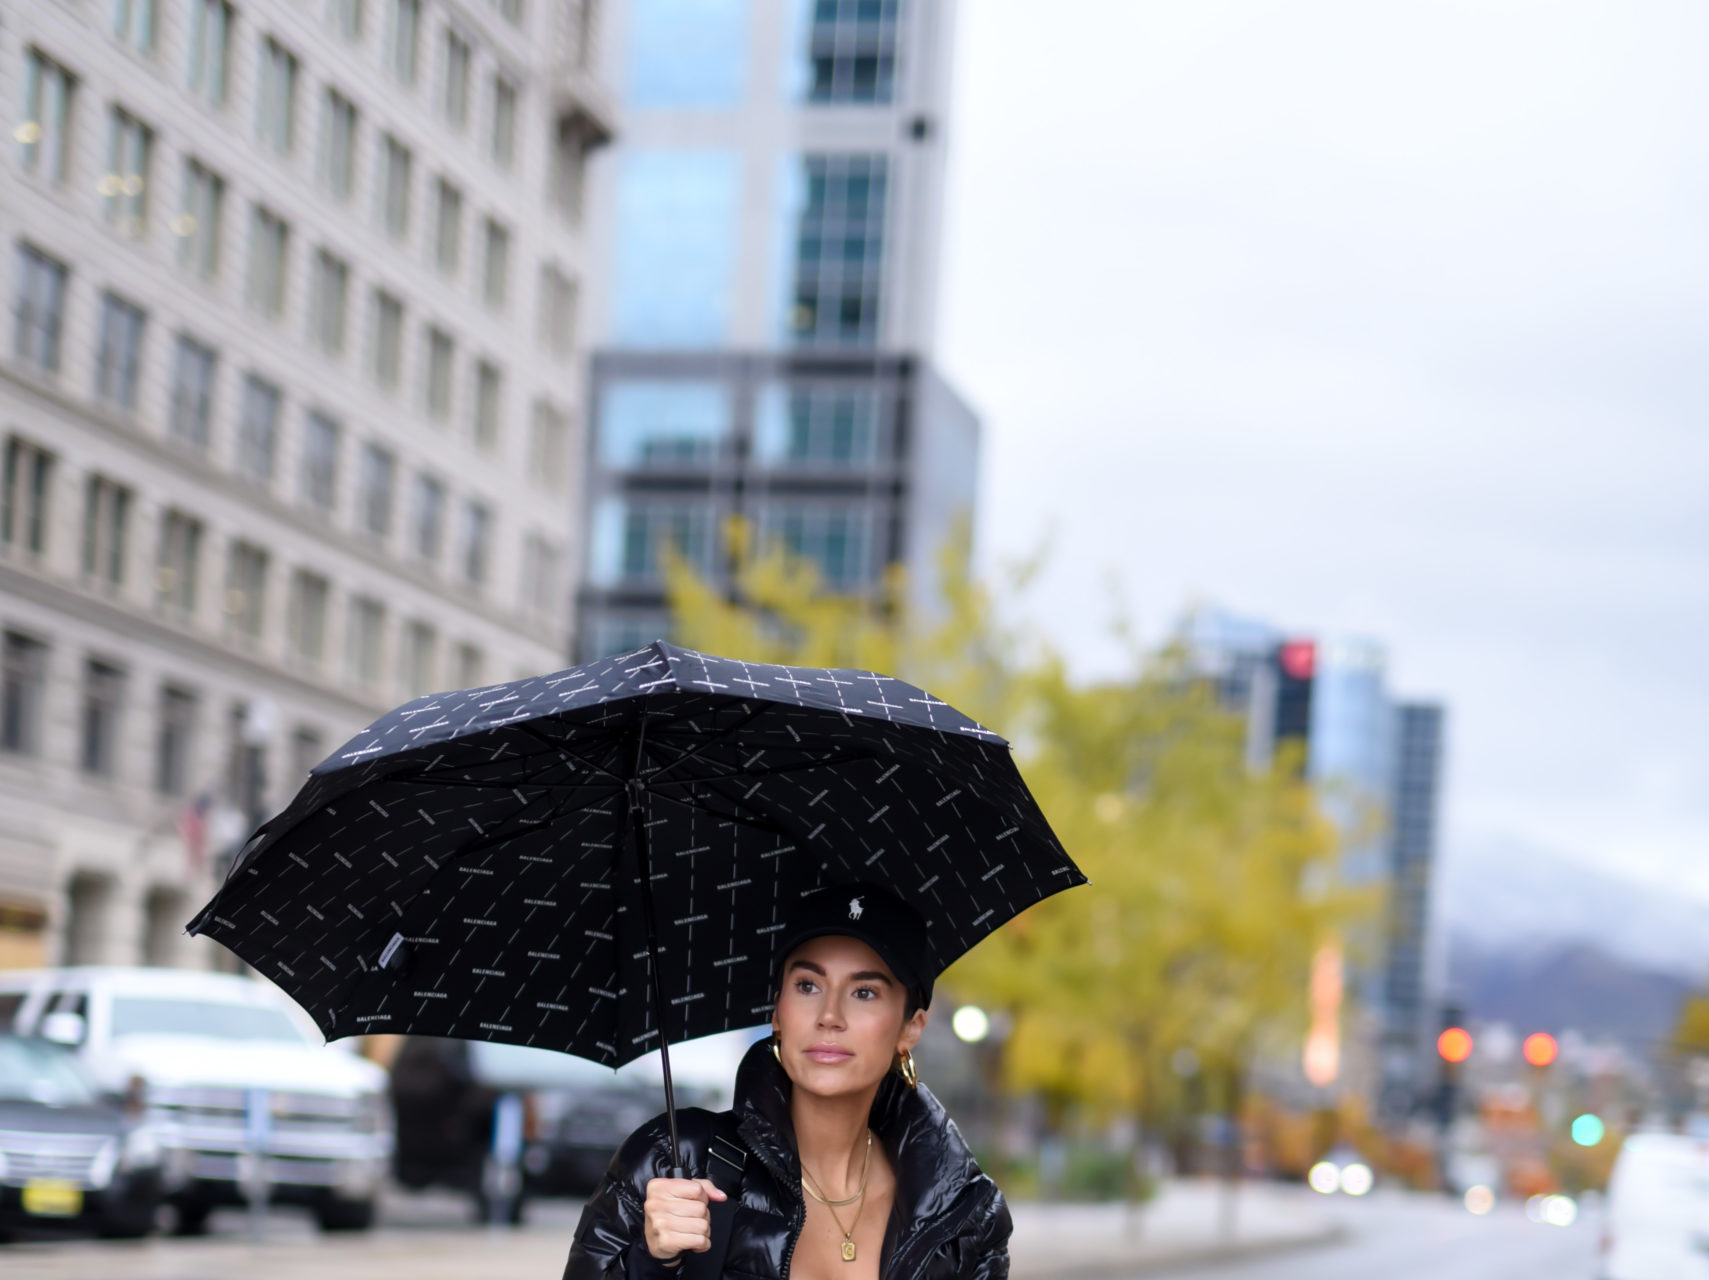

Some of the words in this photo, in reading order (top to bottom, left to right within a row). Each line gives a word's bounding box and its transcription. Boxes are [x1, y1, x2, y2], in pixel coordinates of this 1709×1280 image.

[675, 846, 710, 856] BALENCIAGA
[760, 846, 796, 858] BALENCIAGA
[519, 855, 553, 863] BALENCIAGA
[459, 867, 494, 875] BALENCIAGA
[717, 879, 752, 890] BALENCIAGA
[463, 918, 497, 926] BALENCIAGA
[674, 914, 708, 925] BALENCIAGA
[528, 951, 560, 959] BALENCIAGA
[713, 956, 748, 967] BALENCIAGA
[472, 968, 505, 976] BALENCIAGA
[671, 993, 704, 1005] BALENCIAGA
[537, 1002, 568, 1011] BALENCIAGA
[480, 1022, 512, 1031] BALENCIAGA
